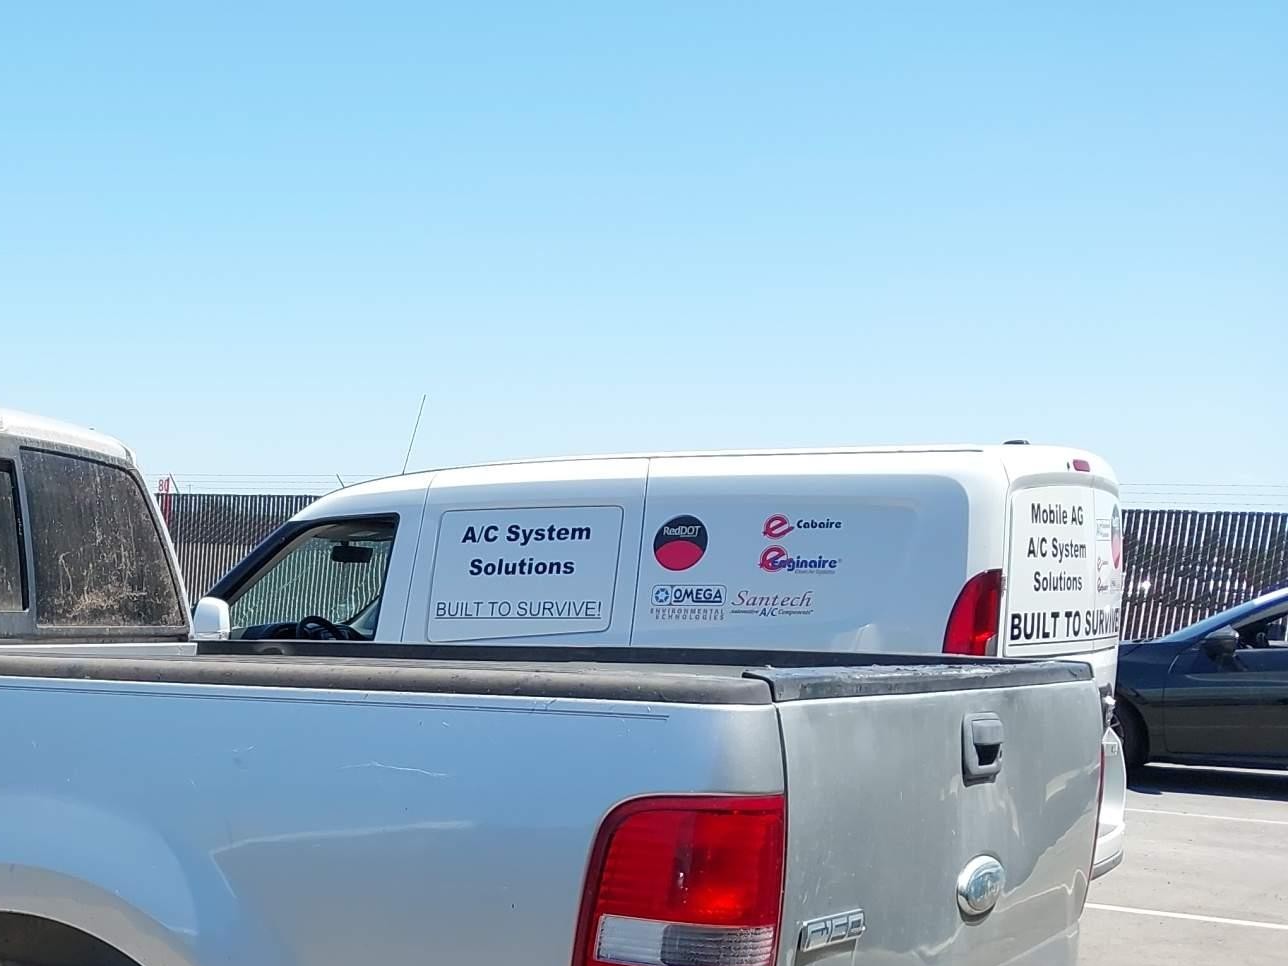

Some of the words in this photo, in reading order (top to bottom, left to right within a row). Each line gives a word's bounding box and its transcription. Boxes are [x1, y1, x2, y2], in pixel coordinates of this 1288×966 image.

[1031, 503, 1067, 525] Mobile
[1070, 505, 1084, 526] AG
[796, 519, 842, 529] Cabaire
[461, 525, 499, 543] A/C
[506, 524, 591, 546] System
[1027, 537, 1048, 558] A/C
[1051, 537, 1087, 563] System
[469, 558, 575, 576] Solutions
[1033, 571, 1083, 592] Solutions
[673, 588, 723, 602] OMEGA
[731, 590, 813, 607] Santech
[436, 602, 483, 617] BUILT
[487, 601, 511, 617] TO
[516, 601, 602, 617] SURVIVE!
[759, 607, 778, 616] A/C
[1010, 611, 1060, 640] BUILT
[1064, 610, 1081, 637] TO
